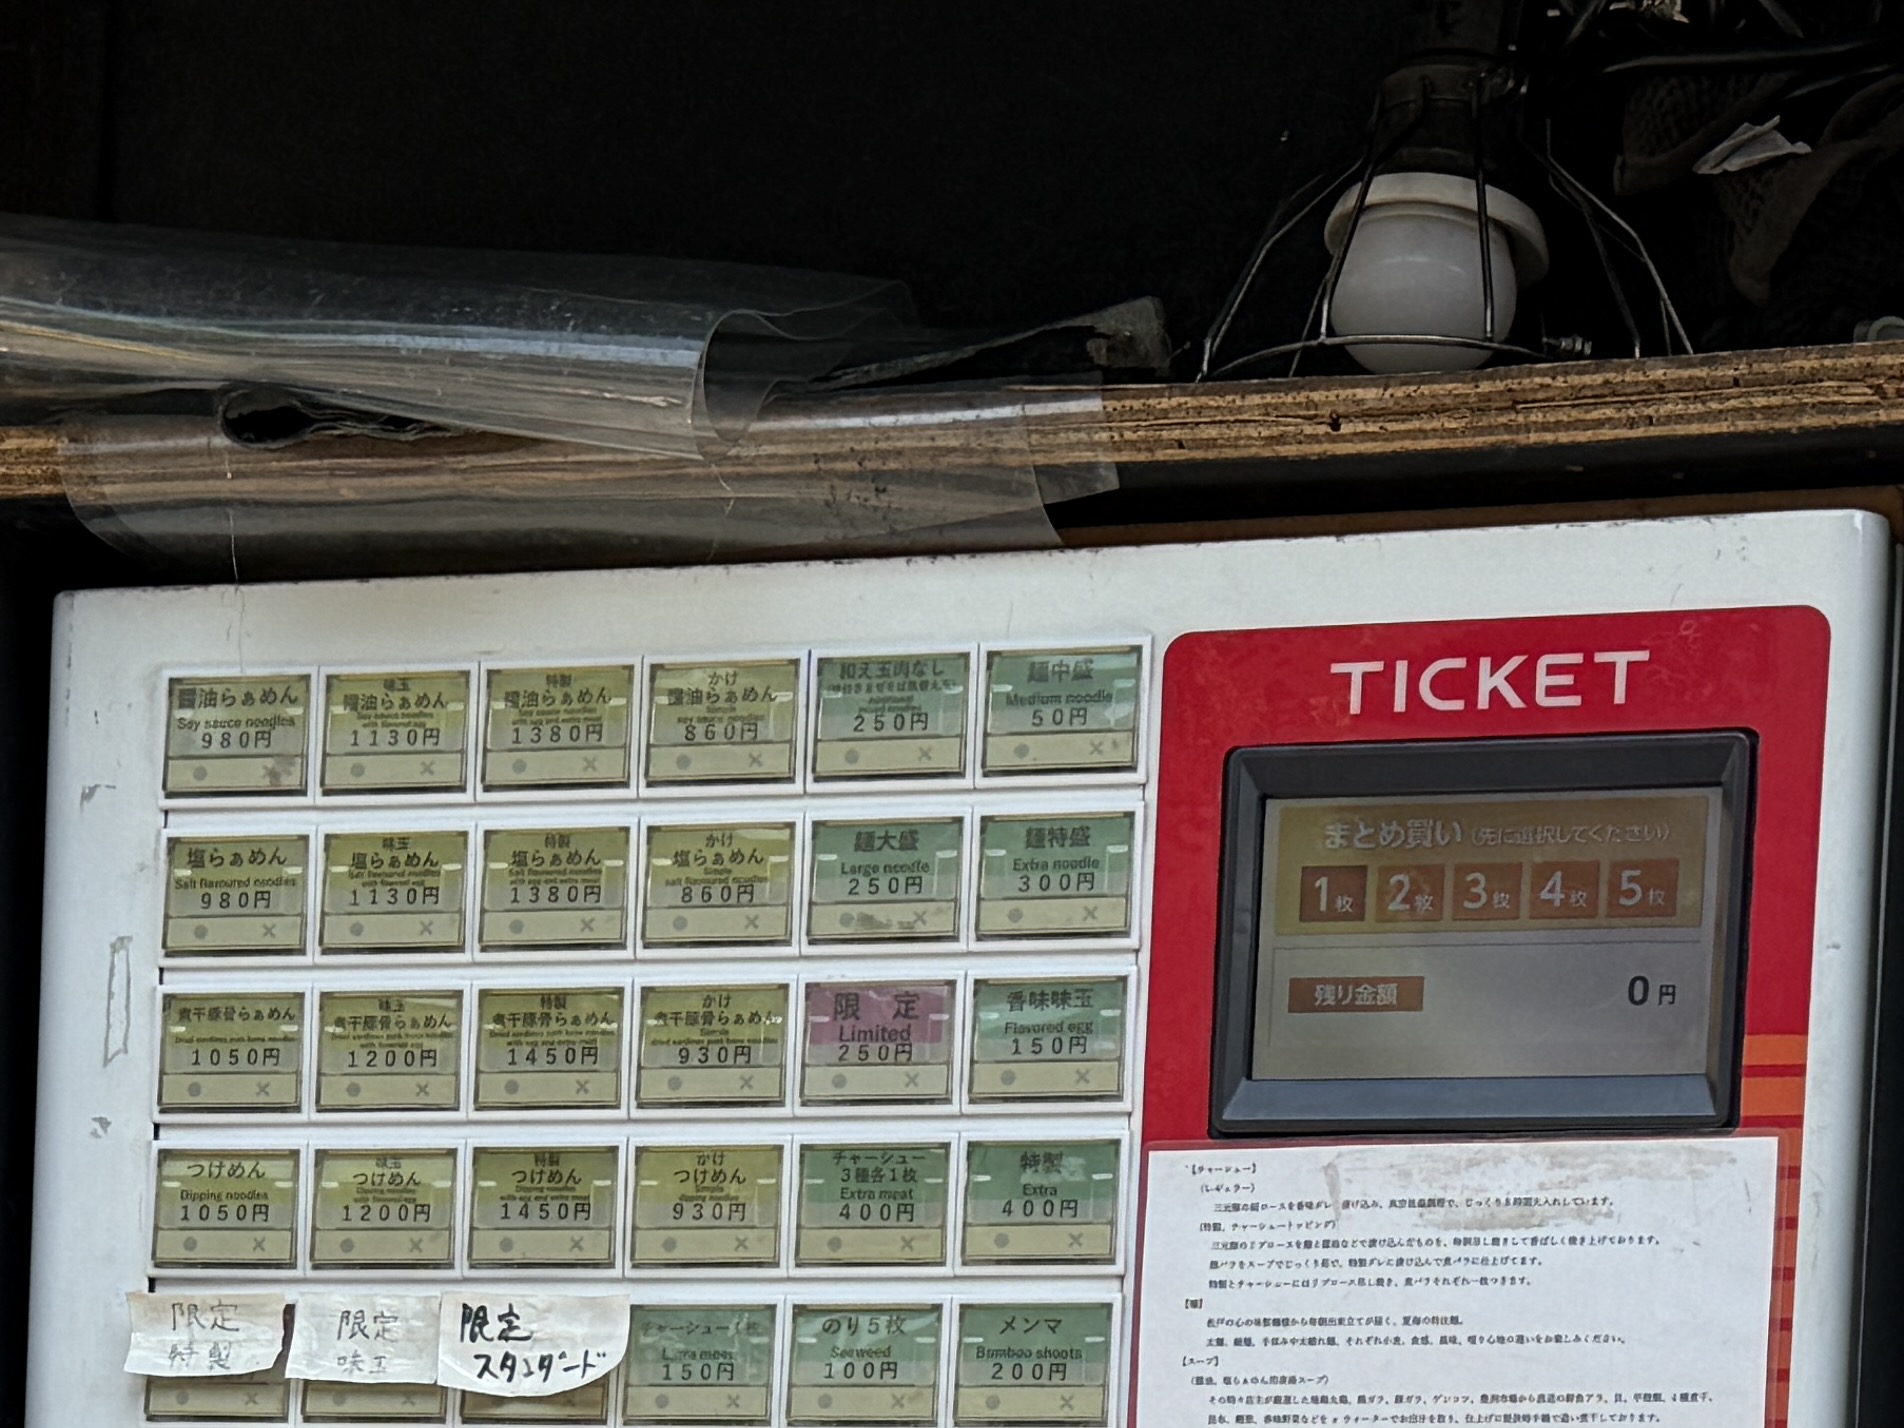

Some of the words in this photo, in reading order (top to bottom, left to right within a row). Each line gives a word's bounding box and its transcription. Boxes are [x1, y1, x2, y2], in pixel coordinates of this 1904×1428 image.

[1330, 650, 1650, 714] TICKET
[201, 729, 272, 750] 980円
[350, 727, 440, 748] 1130円
[512, 724, 603, 745] 1380円
[1324, 820, 1461, 849] まとめ買い
[186, 847, 288, 868] 塩らぁめん
[1013, 857, 1049, 871] Extra
[1053, 856, 1100, 870] noodle
[1017, 872, 1095, 893] 300円
[200, 890, 272, 910] 980円
[1314, 982, 1397, 1006] 残り金額
[839, 1025, 912, 1043] Limited
[1004, 1021, 1064, 1035] Flavored
[1068, 1022, 1093, 1036] egg
[187, 1160, 266, 1180] つけめん
[180, 1189, 223, 1204] Dipping
[225, 1189, 268, 1201] noodles
[180, 1203, 269, 1222] 1050円
[460, 1303, 532, 1343] 限定
[822, 1316, 906, 1335] のり5枚
[1000, 1316, 1063, 1335] メンマ
[1035, 1346, 1082, 1359] shoots
